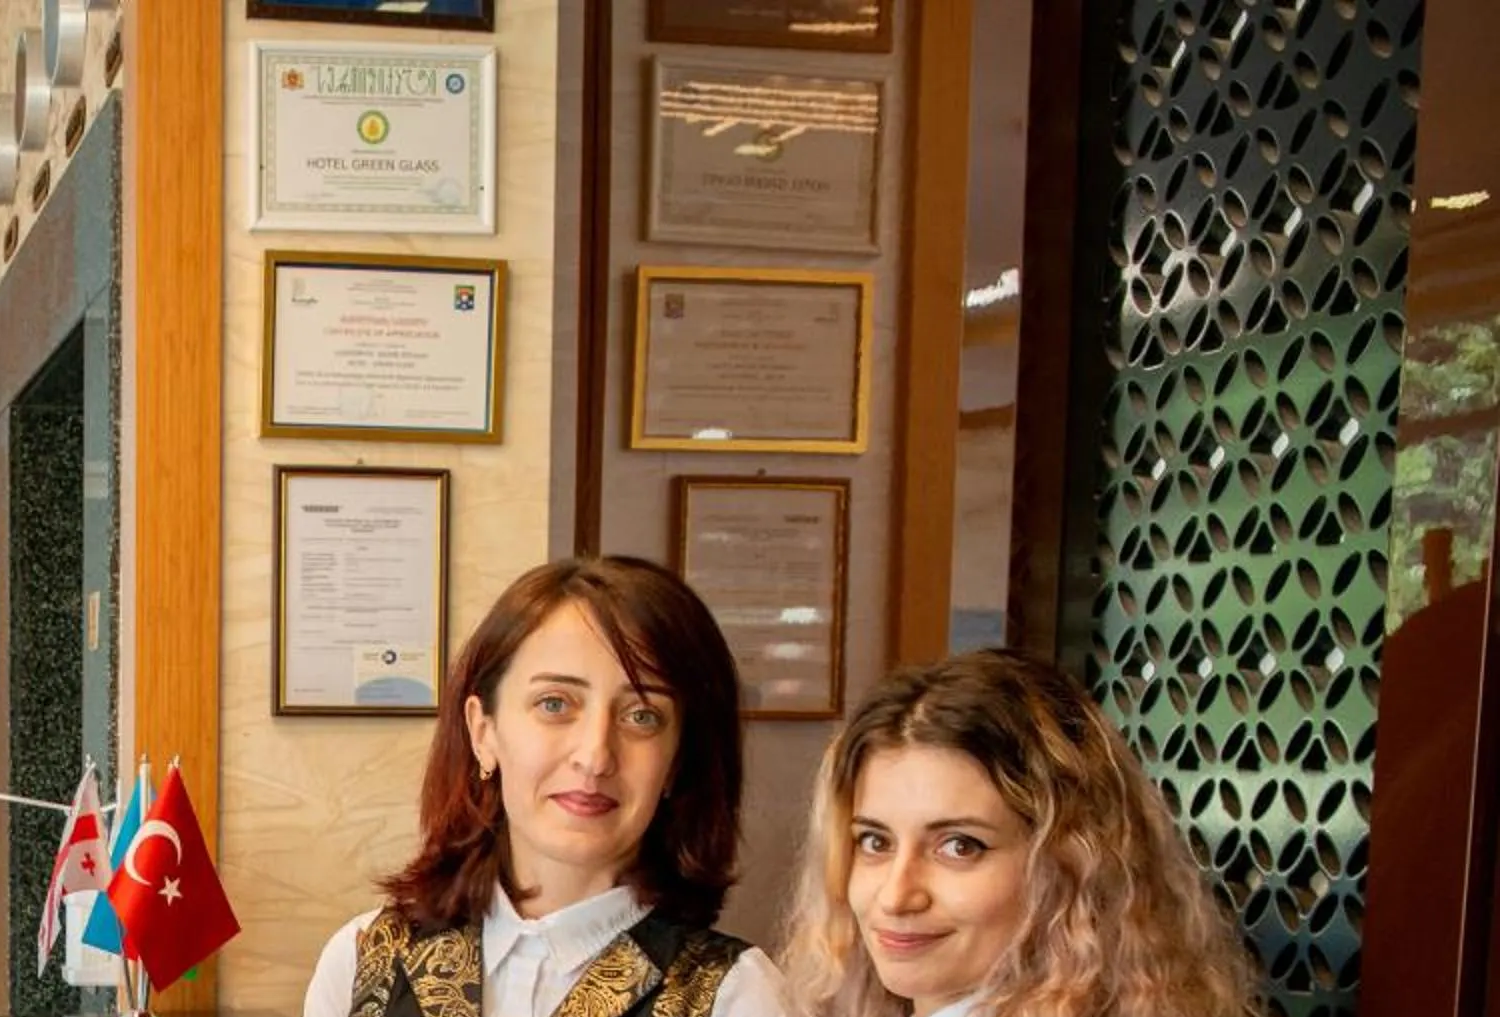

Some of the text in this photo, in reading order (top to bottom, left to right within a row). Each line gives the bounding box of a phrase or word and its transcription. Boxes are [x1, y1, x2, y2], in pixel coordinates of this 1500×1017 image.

[307, 157, 441, 172] HOTEL GREEN GLASS
